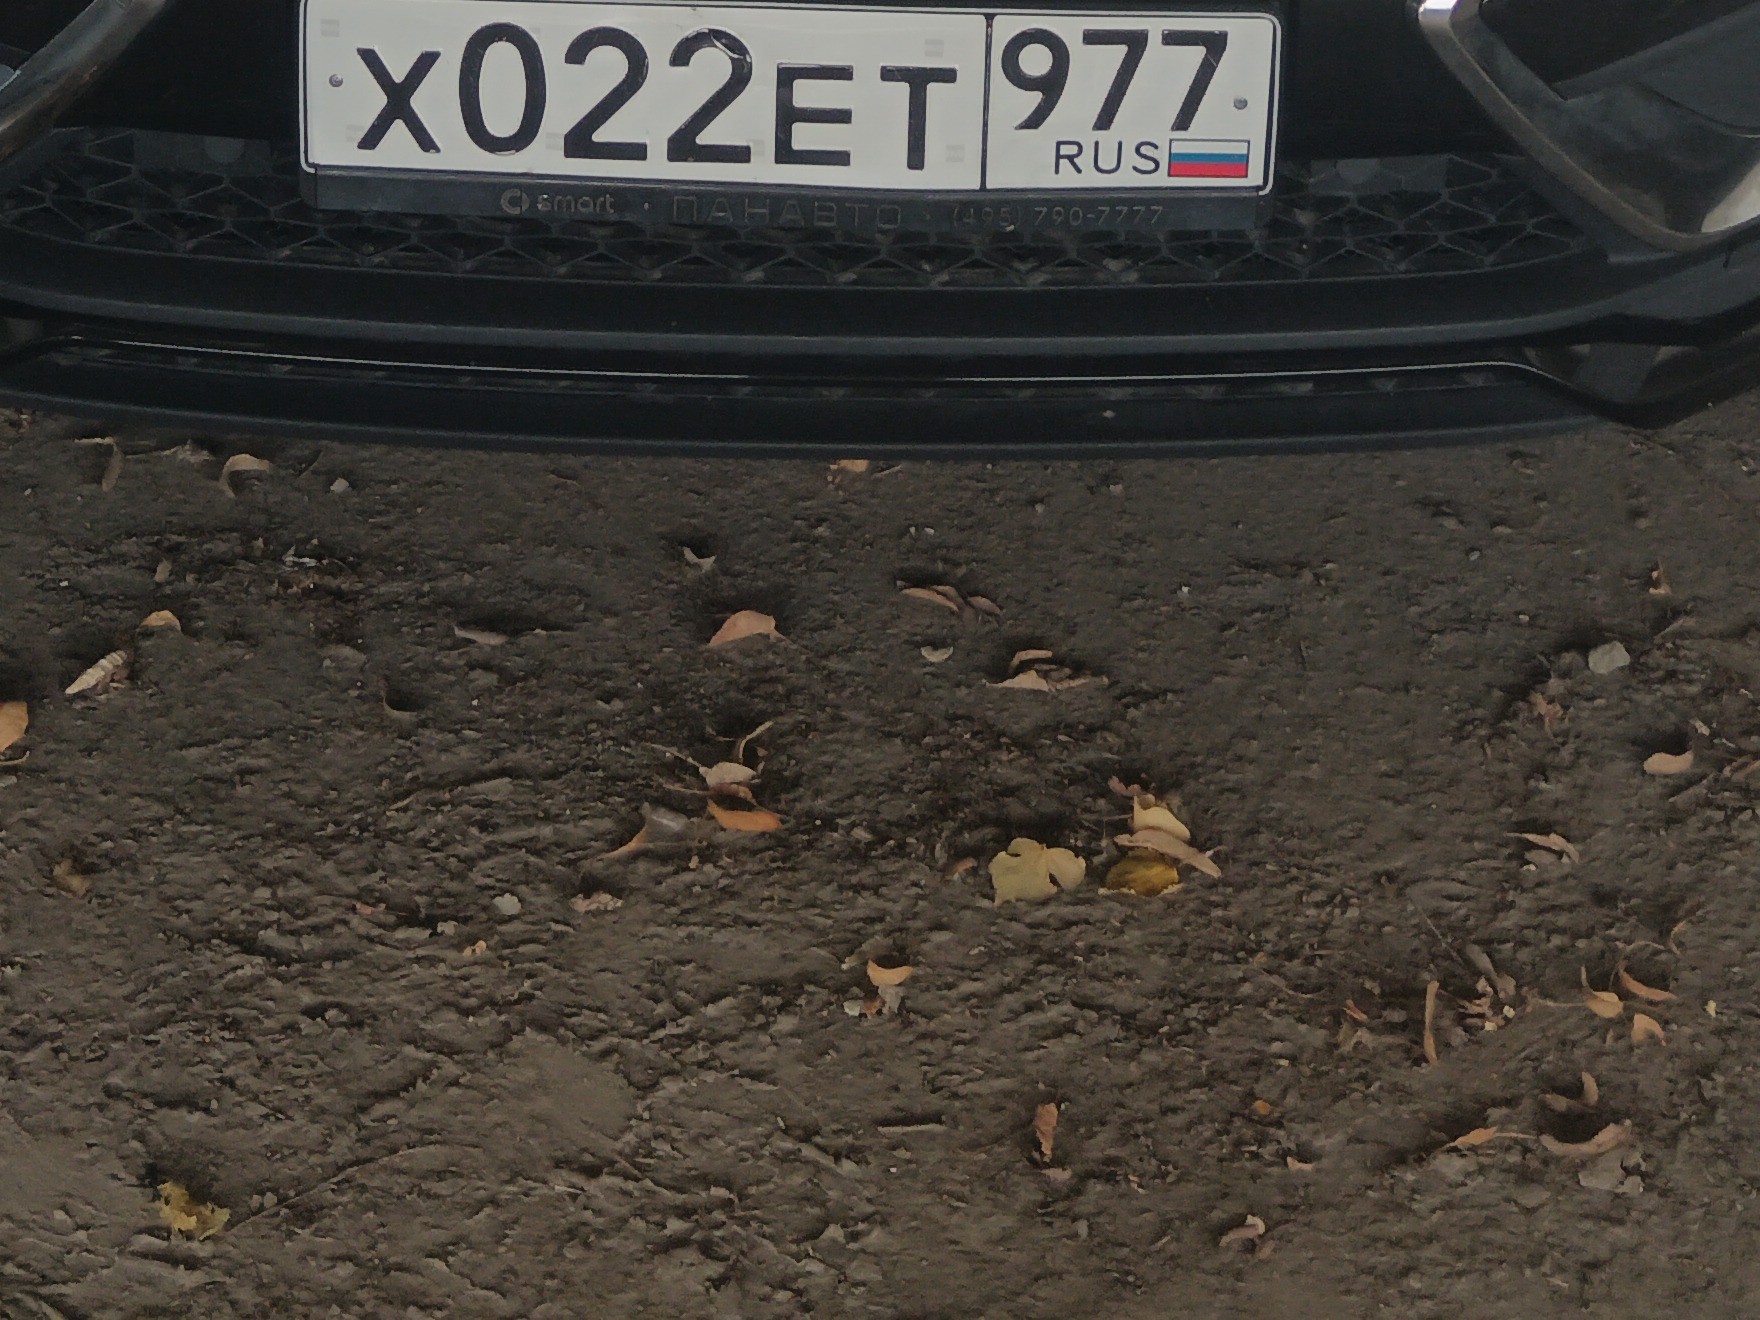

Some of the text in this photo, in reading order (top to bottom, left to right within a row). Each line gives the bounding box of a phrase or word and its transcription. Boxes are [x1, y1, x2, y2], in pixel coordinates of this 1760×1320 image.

[1001, 27, 1229, 132] 977
[1054, 139, 1161, 176] RUS
[537, 193, 1164, 232] smart ПАНАВТО (495) 790-7777
